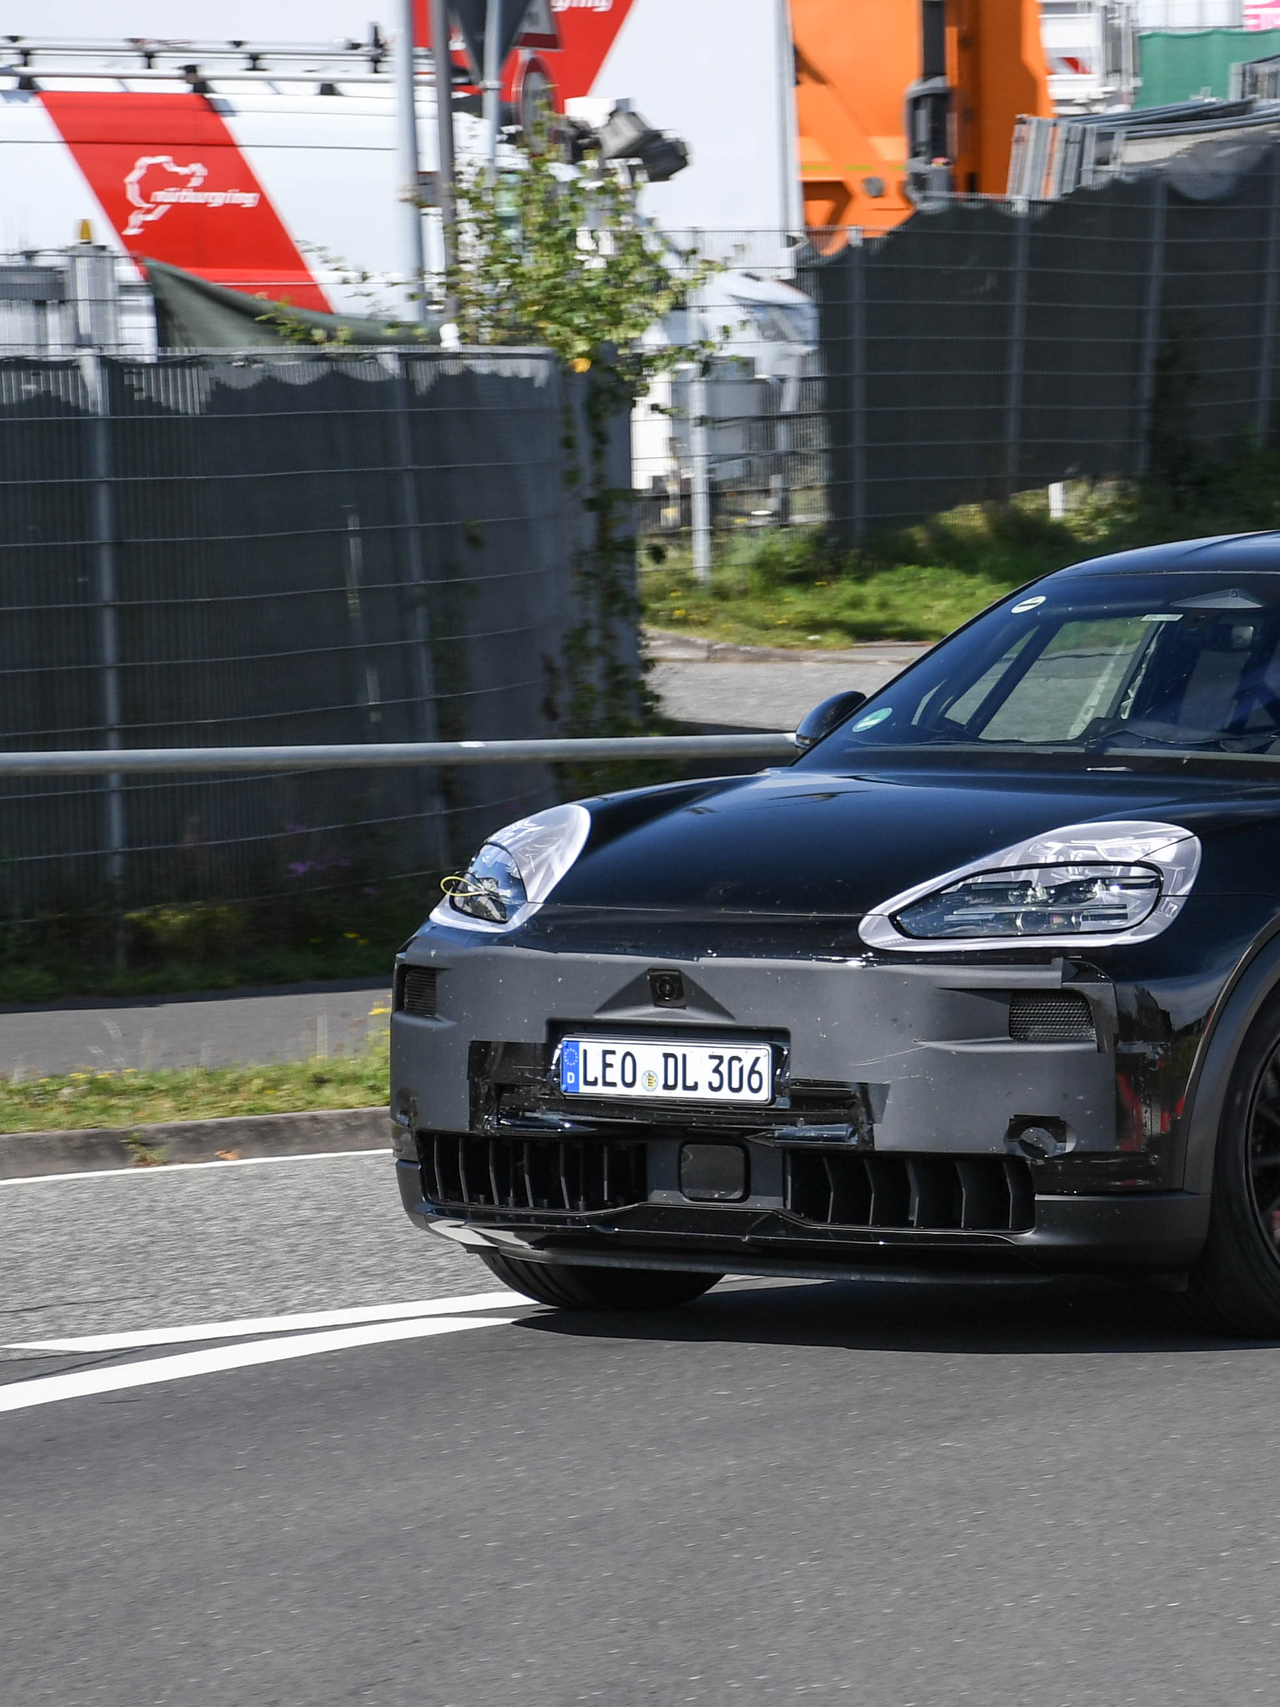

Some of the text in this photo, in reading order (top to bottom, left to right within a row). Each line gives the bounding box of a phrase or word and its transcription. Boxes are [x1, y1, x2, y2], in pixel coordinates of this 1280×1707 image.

[566, 1072, 576, 1084] D
[582, 1048, 764, 1094] LEO DL 306
